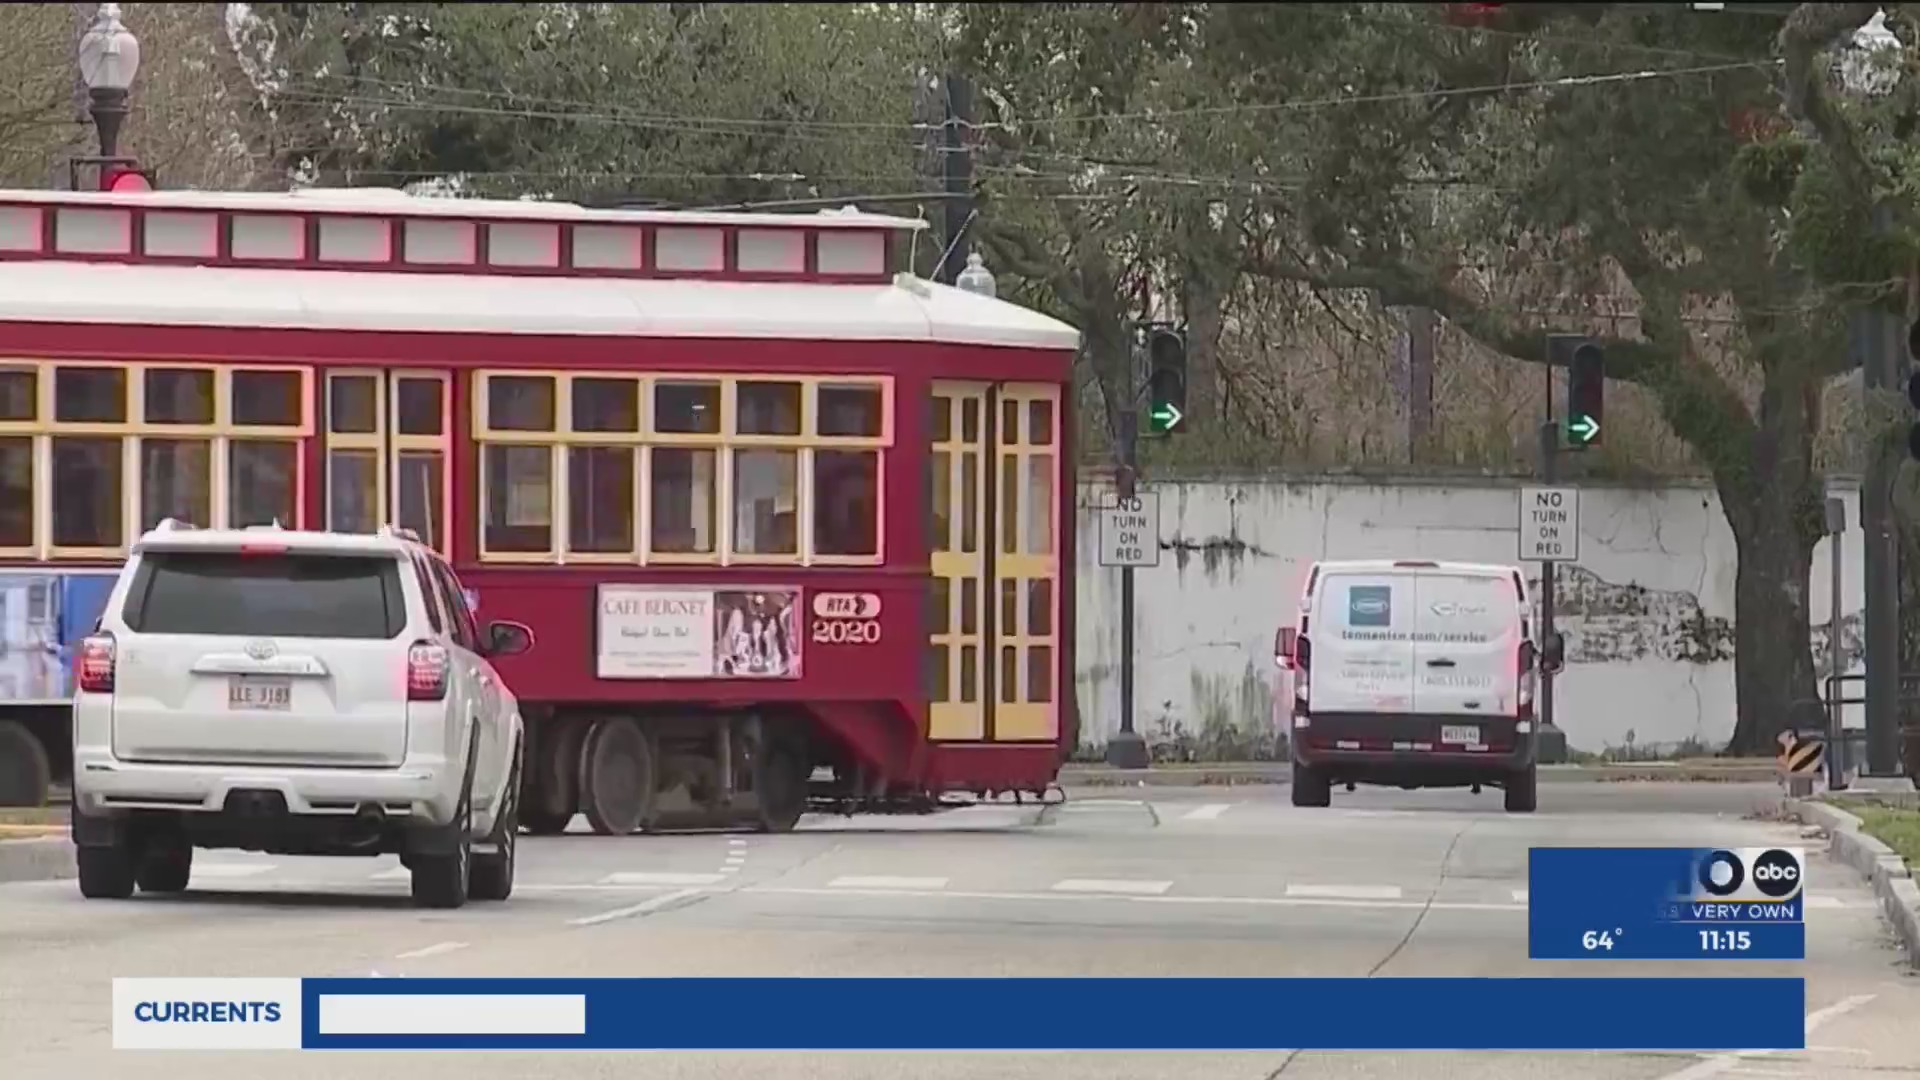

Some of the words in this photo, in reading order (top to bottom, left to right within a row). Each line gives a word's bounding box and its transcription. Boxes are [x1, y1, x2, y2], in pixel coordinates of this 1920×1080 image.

[1117, 497, 1142, 512] NO
[1537, 492, 1562, 507] NO
[1112, 515, 1147, 528] TURN
[1532, 510, 1567, 522] TURN
[1120, 532, 1138, 544] ON
[1540, 527, 1558, 538] ON
[1116, 547, 1142, 561] RED
[1536, 542, 1562, 555] RED
[604, 600, 640, 616] CAFE
[645, 599, 707, 616] BEIGNET
[826, 597, 851, 613] RTA
[812, 620, 881, 643] 2020
